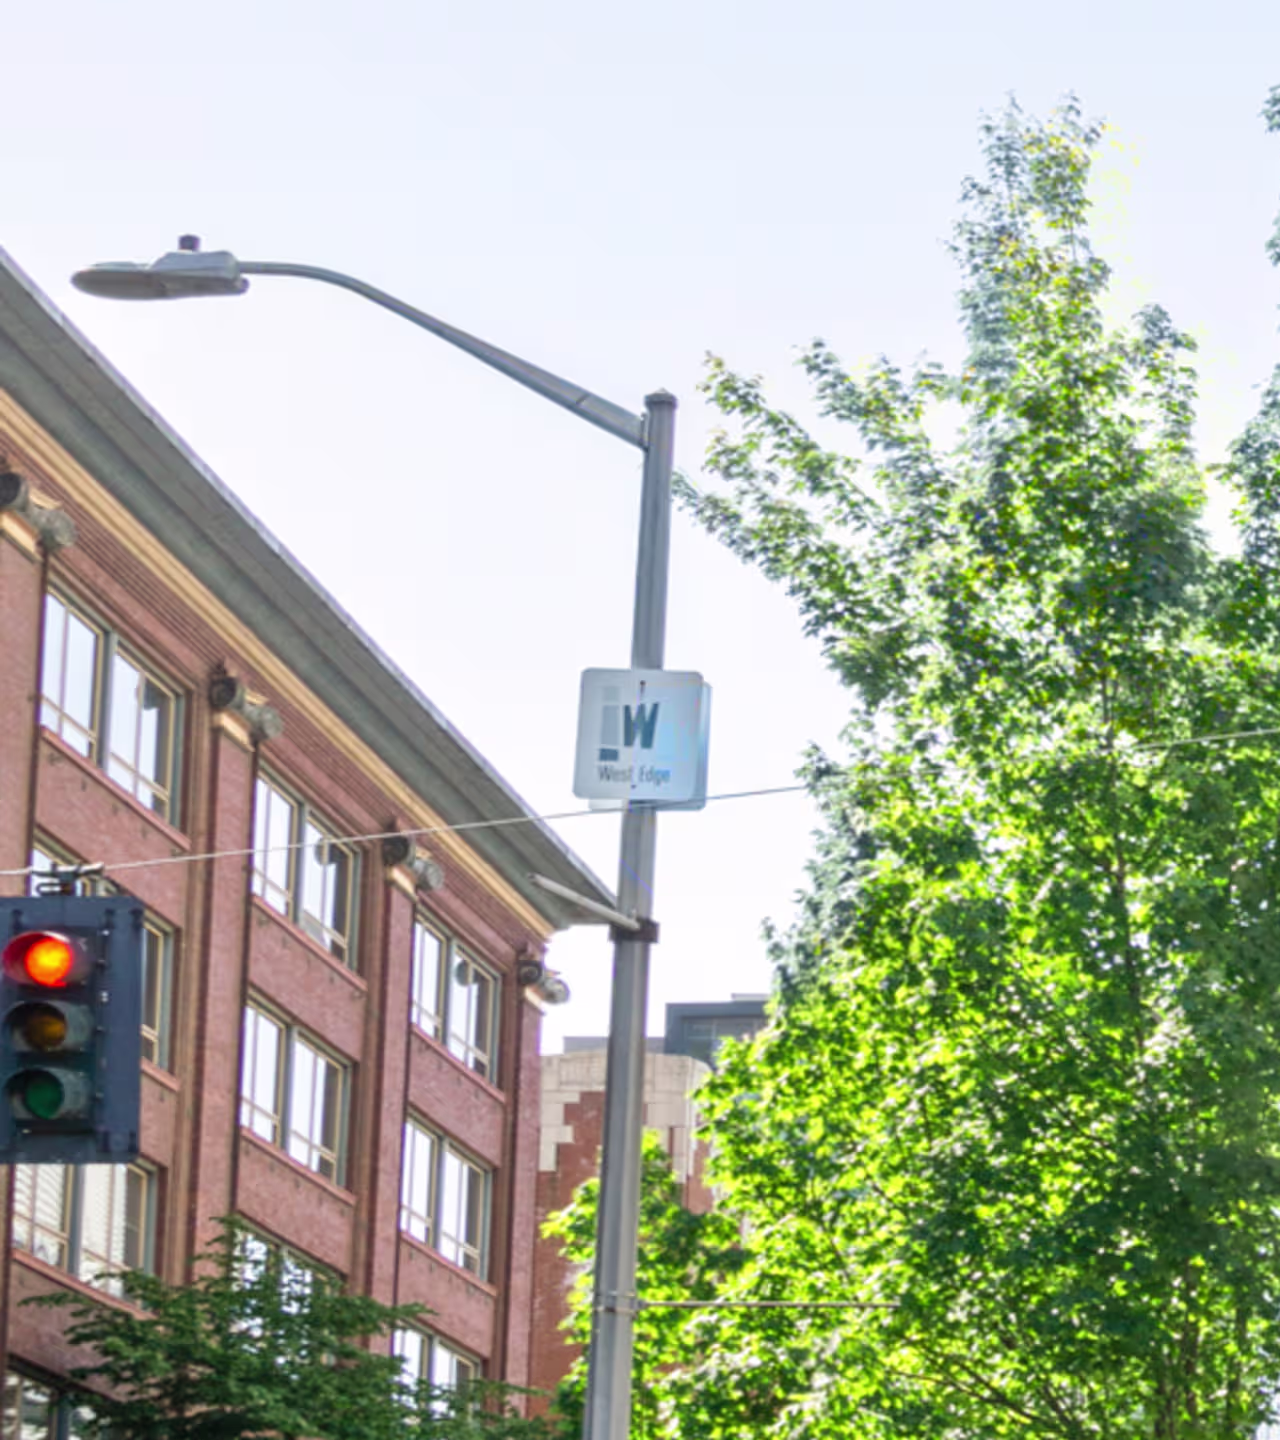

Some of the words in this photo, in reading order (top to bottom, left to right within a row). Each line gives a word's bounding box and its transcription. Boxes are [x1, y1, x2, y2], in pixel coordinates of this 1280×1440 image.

[622, 702, 660, 750] W
[598, 765, 632, 782] West
[638, 764, 671, 785] Edge
